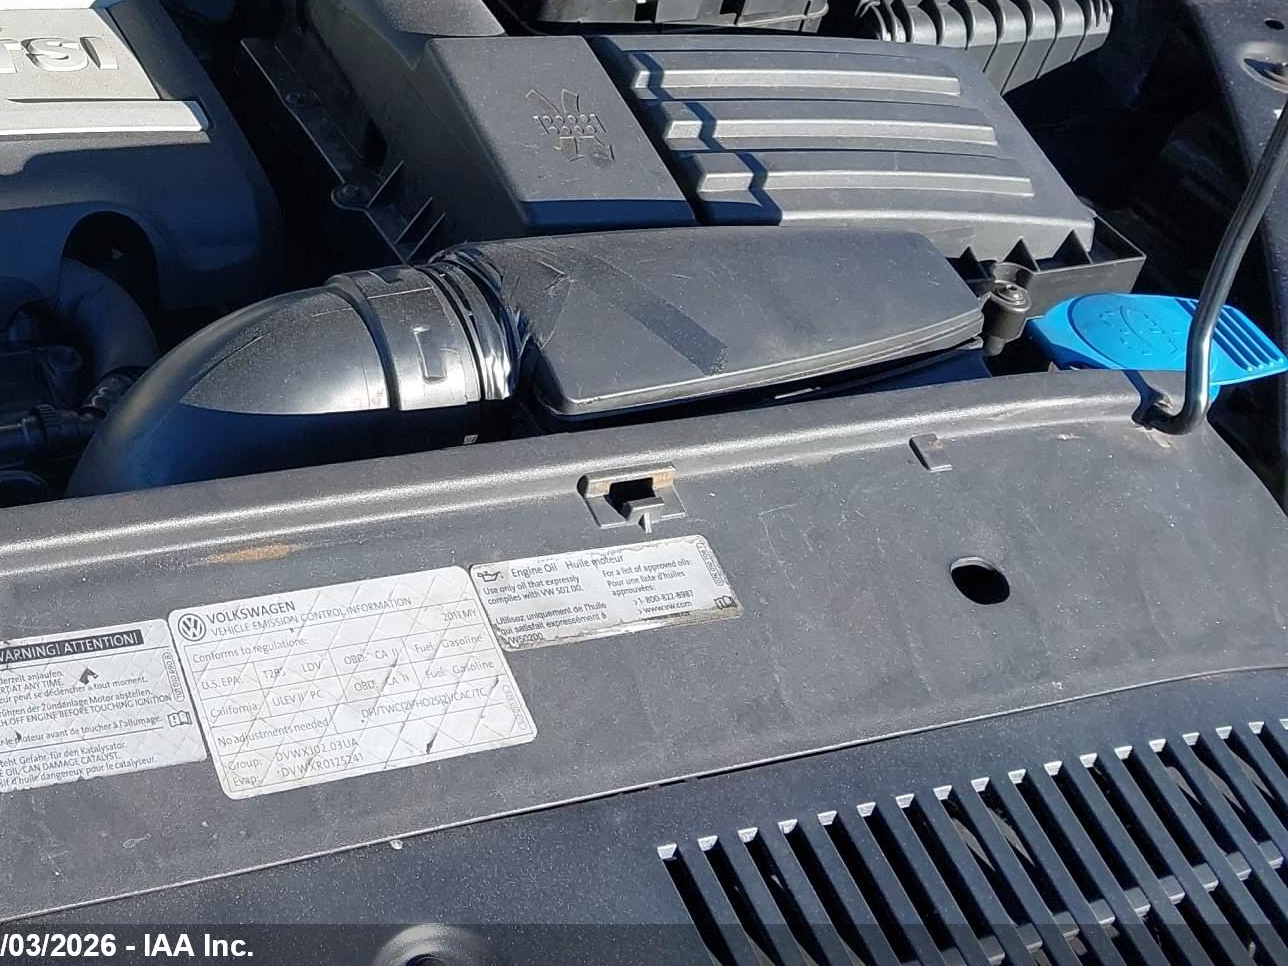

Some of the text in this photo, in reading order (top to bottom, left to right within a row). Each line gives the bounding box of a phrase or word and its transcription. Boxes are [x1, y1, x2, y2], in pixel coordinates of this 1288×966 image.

[512, 555, 623, 578] Engine Oil Huile moteur
[603, 569, 614, 578] For
[634, 565, 642, 573] of
[644, 560, 676, 572] approved
[483, 576, 579, 595] Use only oil that expressly
[608, 579, 624, 588] Pour
[640, 574, 656, 582] liste
[488, 595, 521, 605] complies
[524, 591, 540, 600] with
[206, 600, 296, 624] VOLKSWAGEN
[210, 596, 412, 636] VEHICLE EMISSION CONTROL INFORMATION
[526, 607, 572, 620] uniquement
[64, 632, 139, 652] ATTENTION!
[193, 650, 238, 664] Conforms
[240, 646, 251, 655] to
[301, 661, 321, 673] LDV
[375, 650, 388, 660] CA
[441, 635, 483, 648] Gasoline
[14, 693, 32, 704] peut
[34, 691, 42, 699] se
[94, 681, 110, 689] tout
[24, 682, 40, 691] ANY
[9, 716, 25, 725] OFF
[27, 713, 58, 723] ENGINE
[59, 707, 89, 718] BEFORE
[91, 700, 134, 713] TOUCHING
[136, 694, 171, 706] IGNITION
[27, 705, 40, 713] der
[89, 695, 113, 703] Motor
[272, 694, 296, 707] ULEV
[46, 730, 68, 739] avant
[70, 726, 80, 735] de
[81, 724, 111, 734] toucher
[218, 737, 232, 746] No
[294, 717, 329, 732] needed
[64, 749, 79, 757] den
[23, 764, 41, 774] CAN
[42, 759, 80, 770] DAMAGE
[40, 768, 83, 782] dangereux
[86, 764, 104, 775] pour
[106, 762, 114, 770] le
